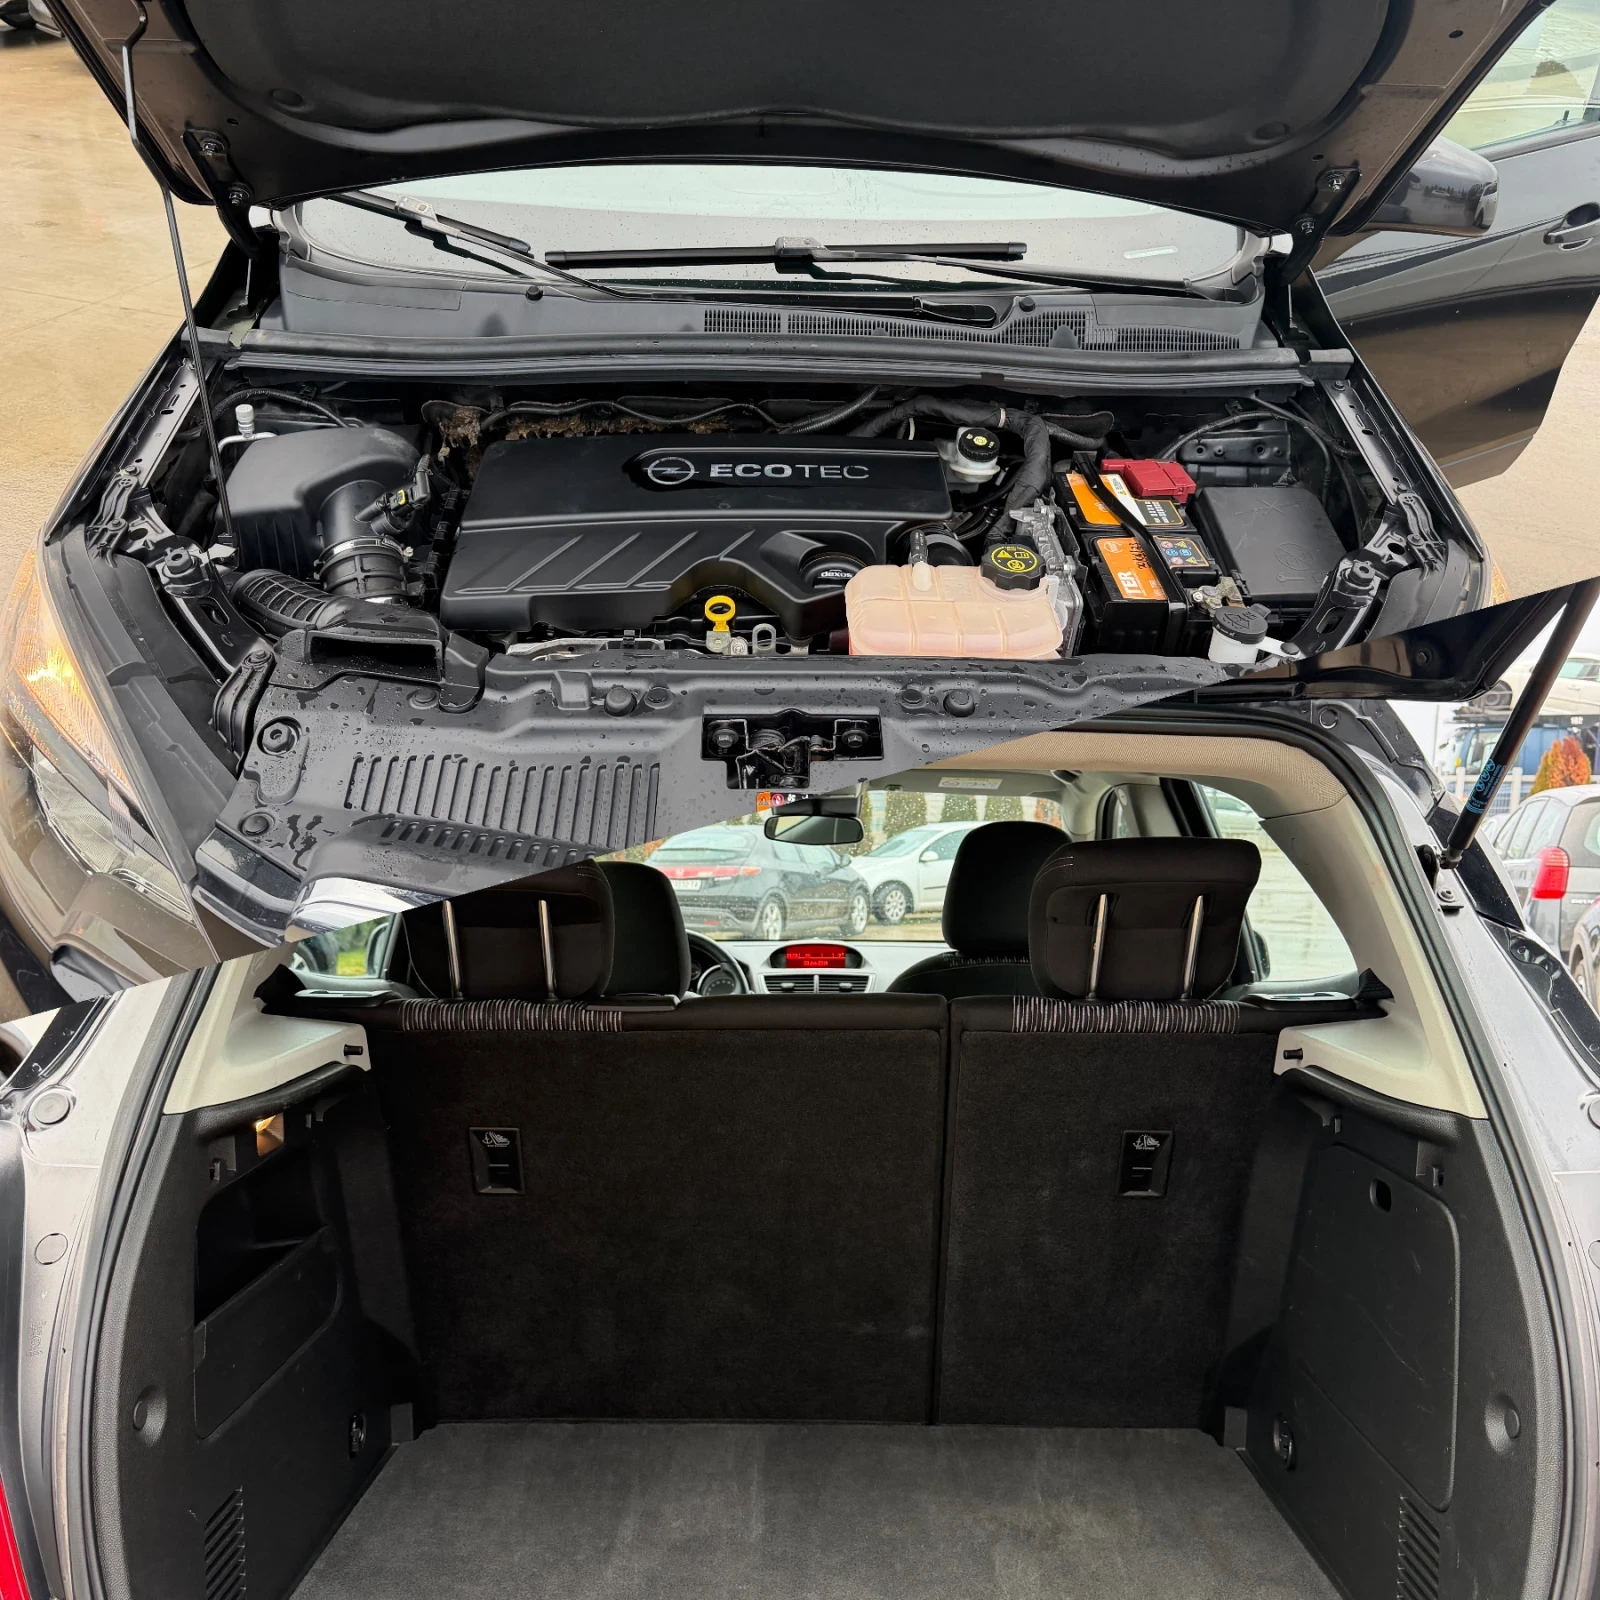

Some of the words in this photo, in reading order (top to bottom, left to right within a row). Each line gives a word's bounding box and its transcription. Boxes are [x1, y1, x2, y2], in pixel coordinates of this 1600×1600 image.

[709, 463, 870, 480] ECOTEC
[820, 570, 853, 578] dexos
[1117, 571, 1141, 595] TER
